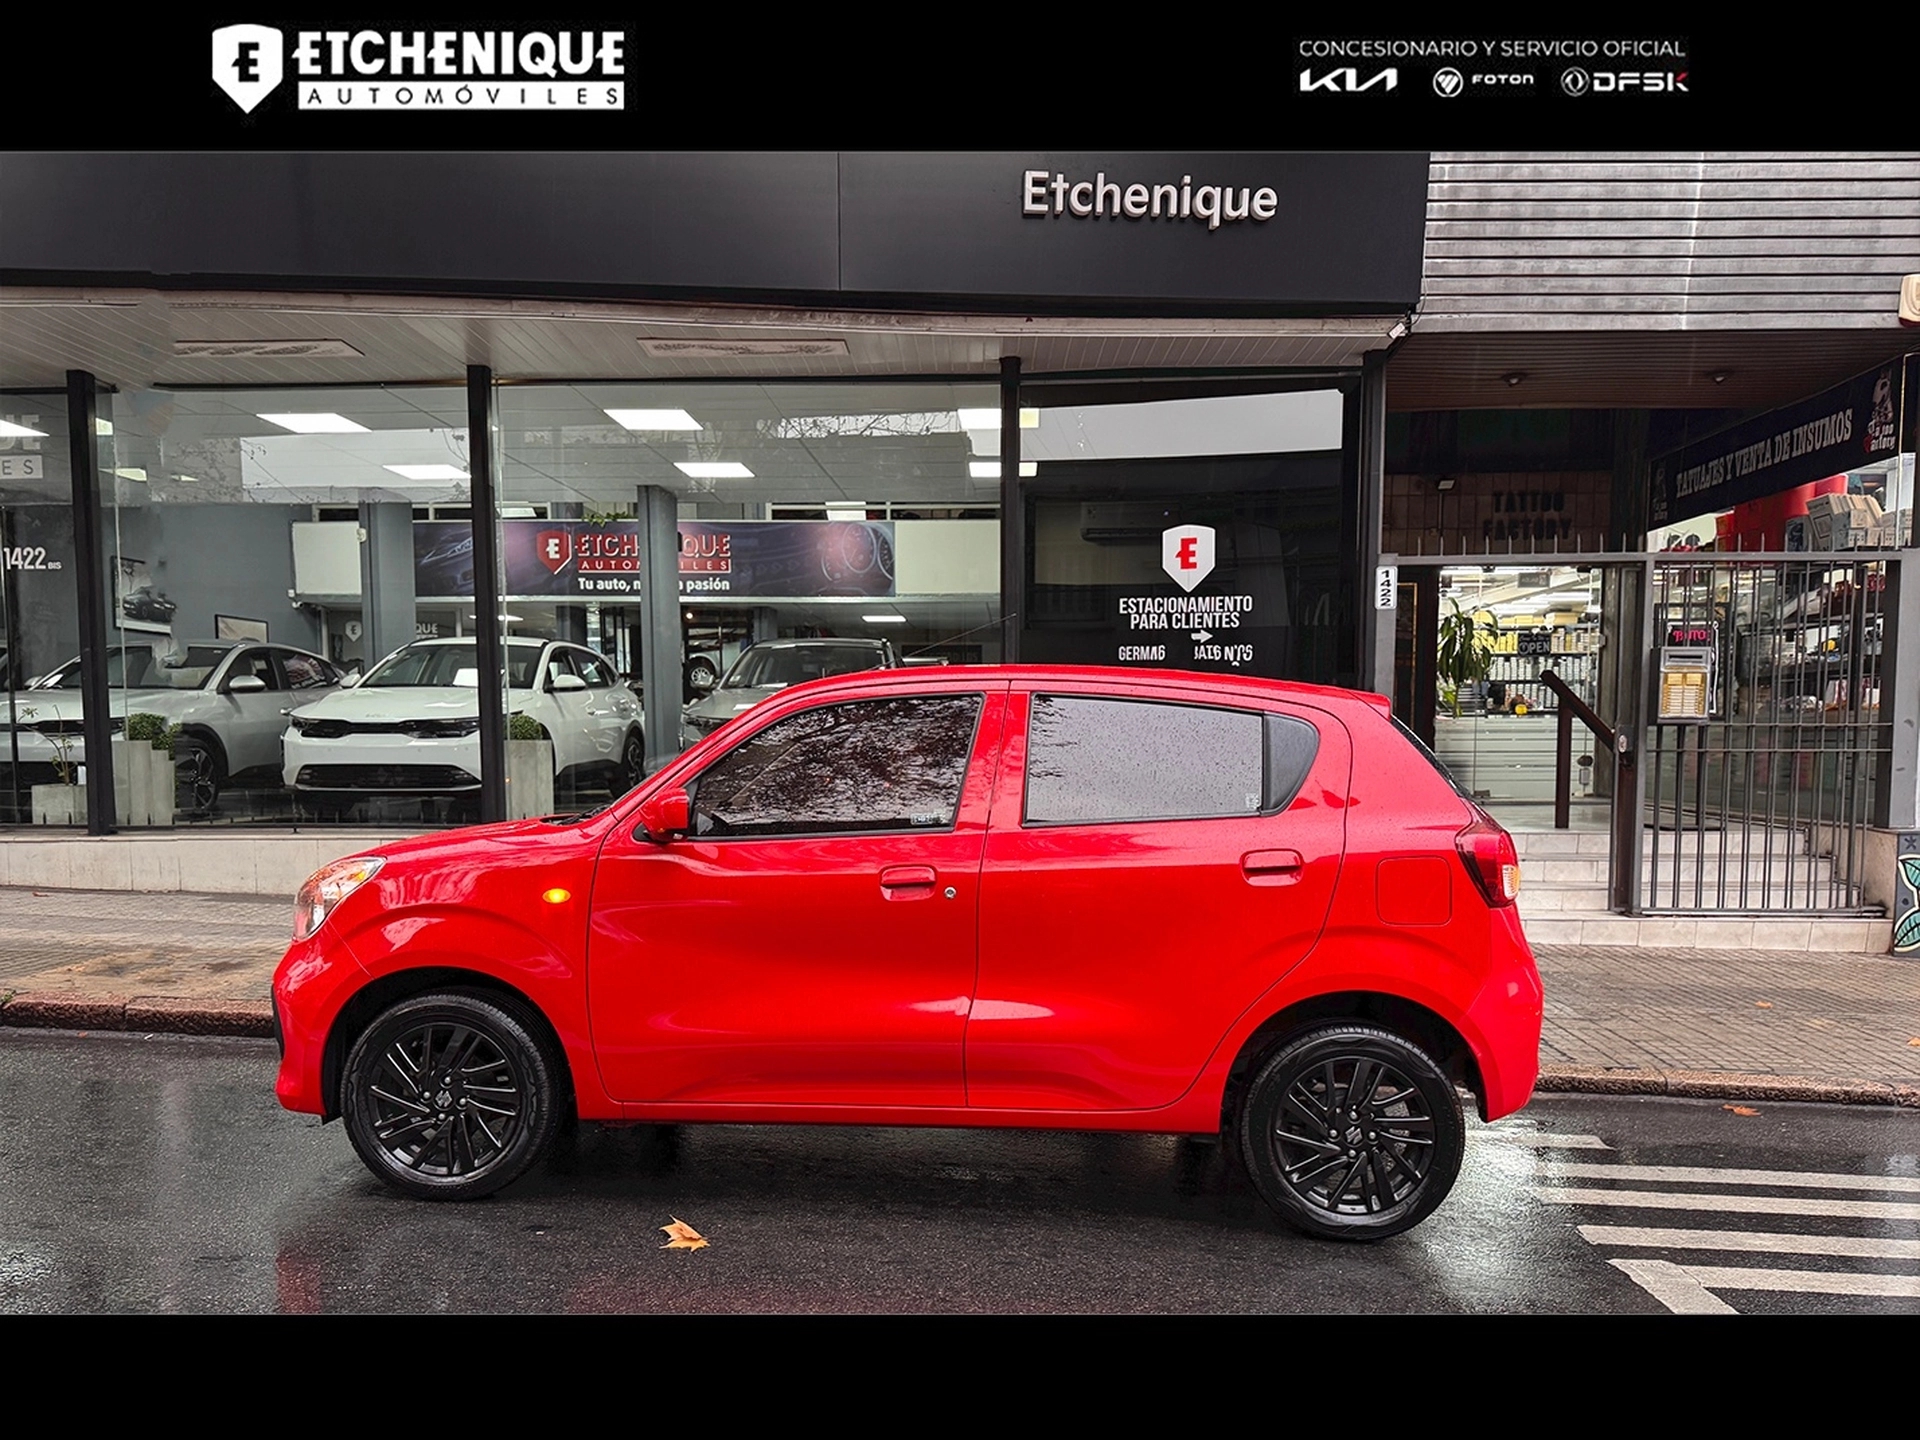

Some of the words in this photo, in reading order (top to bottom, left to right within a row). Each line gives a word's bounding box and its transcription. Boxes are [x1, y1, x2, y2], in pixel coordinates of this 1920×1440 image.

[1023, 170, 1279, 231] Etchenique
[1676, 458, 1725, 499] TATUAJES
[1725, 452, 1734, 481] Y
[1735, 438, 1773, 478] VENTA
[1774, 430, 1791, 464] DE
[1792, 407, 1853, 457] INSUMOS
[4, 546, 46, 570] 1422
[578, 577, 594, 591] Tu
[596, 577, 631, 593] auto,
[687, 575, 730, 592] pasión
[1380, 569, 1391, 607] 1422
[1118, 595, 1253, 614] ESTACIONAMIENTO
[1130, 613, 1168, 630] PARA
[1172, 611, 1240, 629] CLIENTES
[1518, 640, 1550, 656] OPEN
